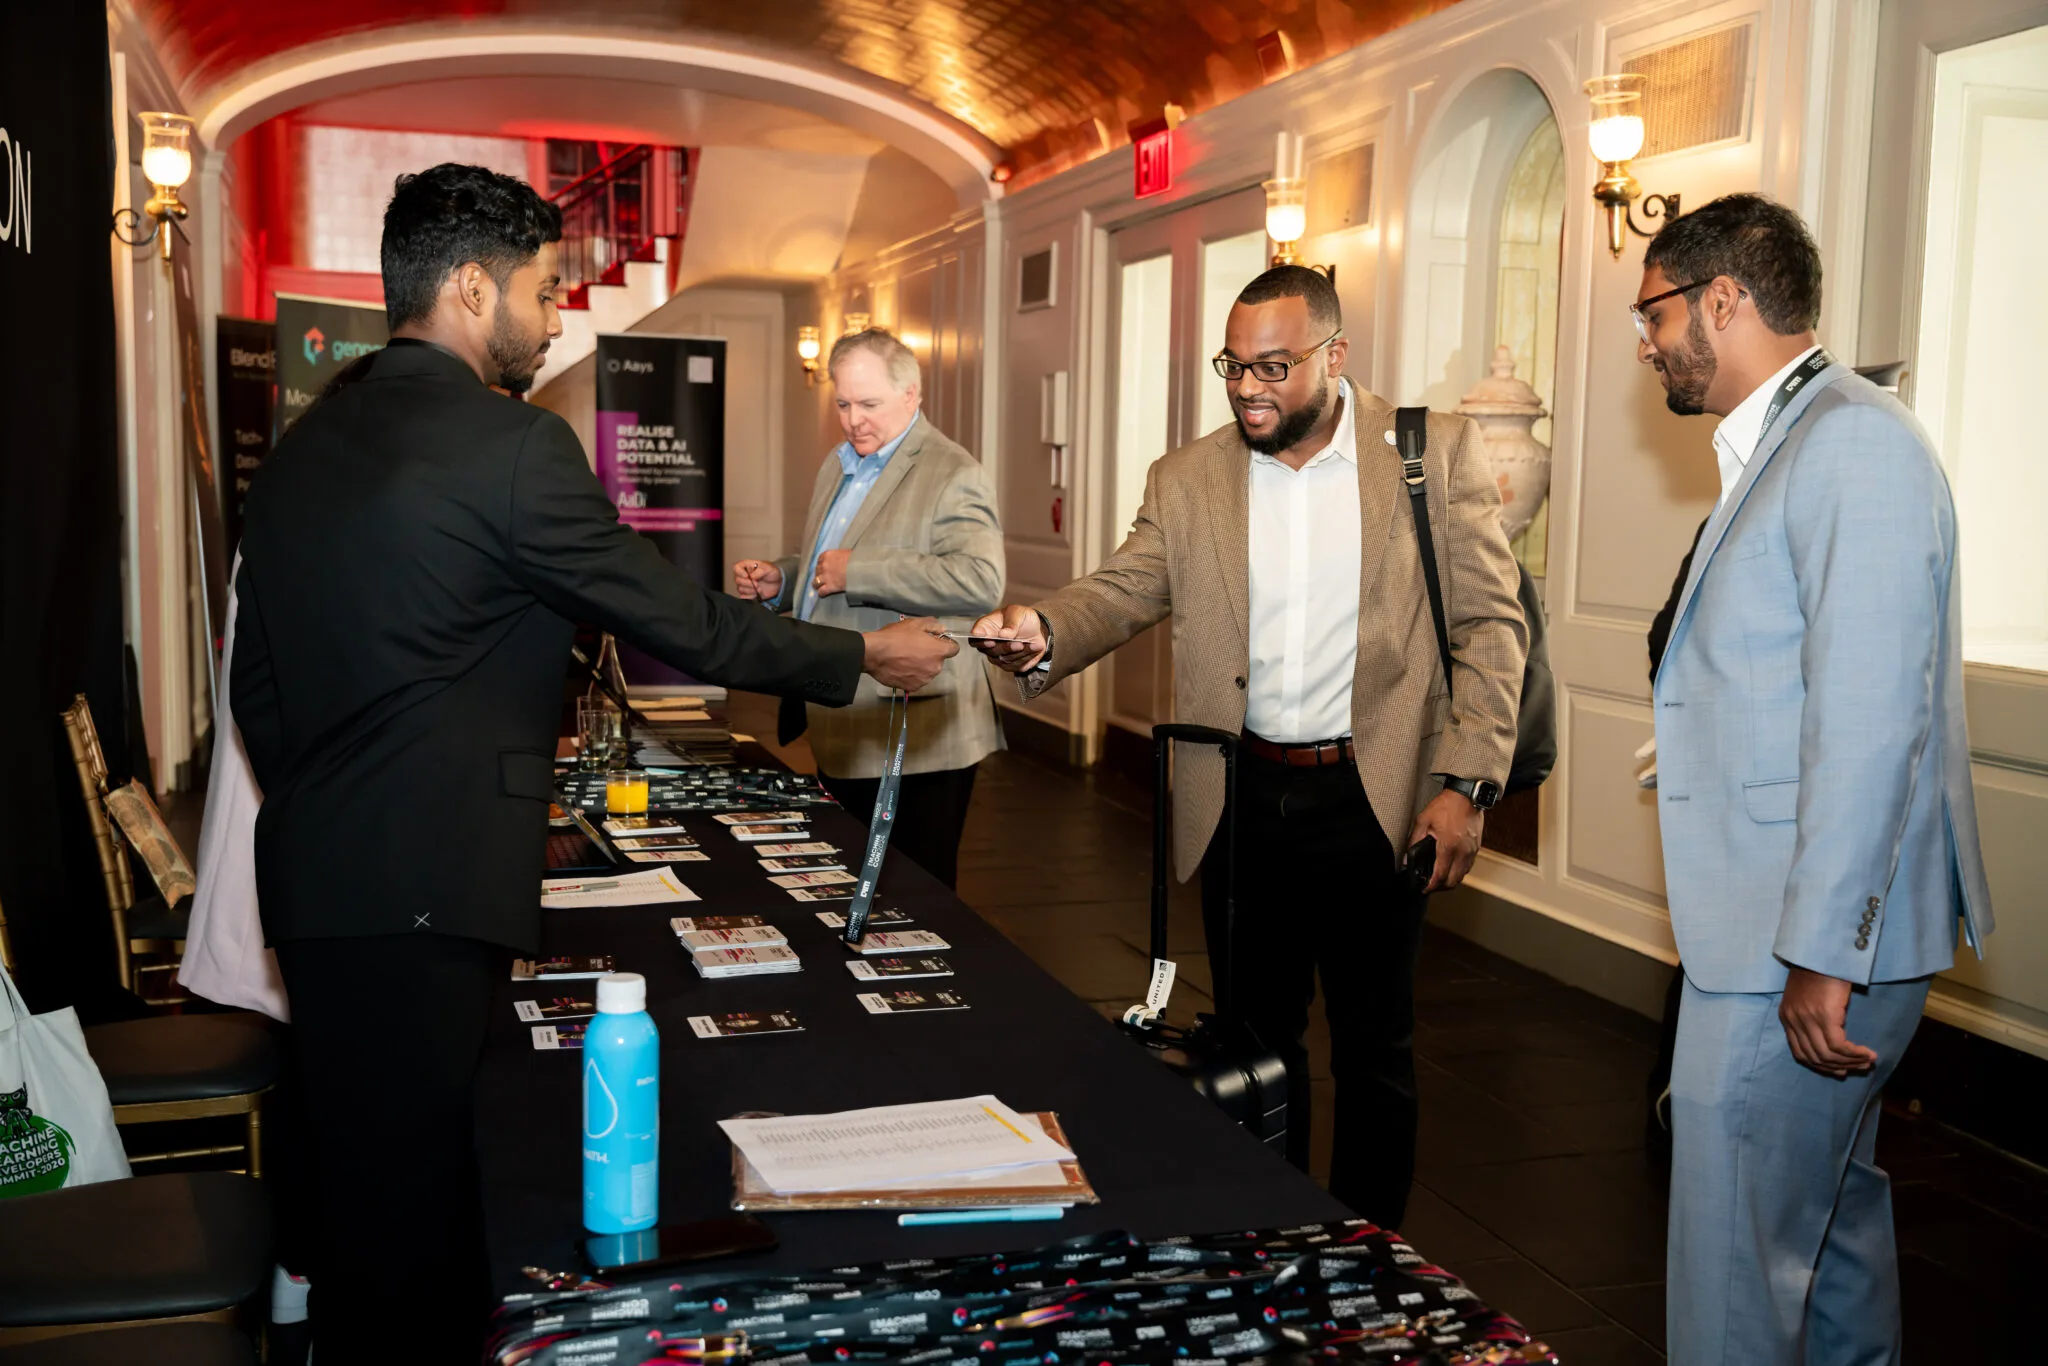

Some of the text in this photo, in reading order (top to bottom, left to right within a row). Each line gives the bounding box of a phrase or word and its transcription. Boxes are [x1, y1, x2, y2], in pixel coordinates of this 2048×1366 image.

[1140, 134, 1167, 193] EXIT
[623, 359, 654, 375] Aays
[616, 425, 674, 438] REALISE
[616, 438, 687, 451] DATA & AI
[616, 452, 695, 465] POTENTIAL
[869, 834, 881, 863] MACHINE
[873, 851, 882, 868] CON
[1152, 972, 1165, 1005] UNITED
[0, 1138, 59, 1167] ARNING
[0, 1149, 61, 1176] VELOPERS
[0, 1157, 66, 1185] MMIT-2020
